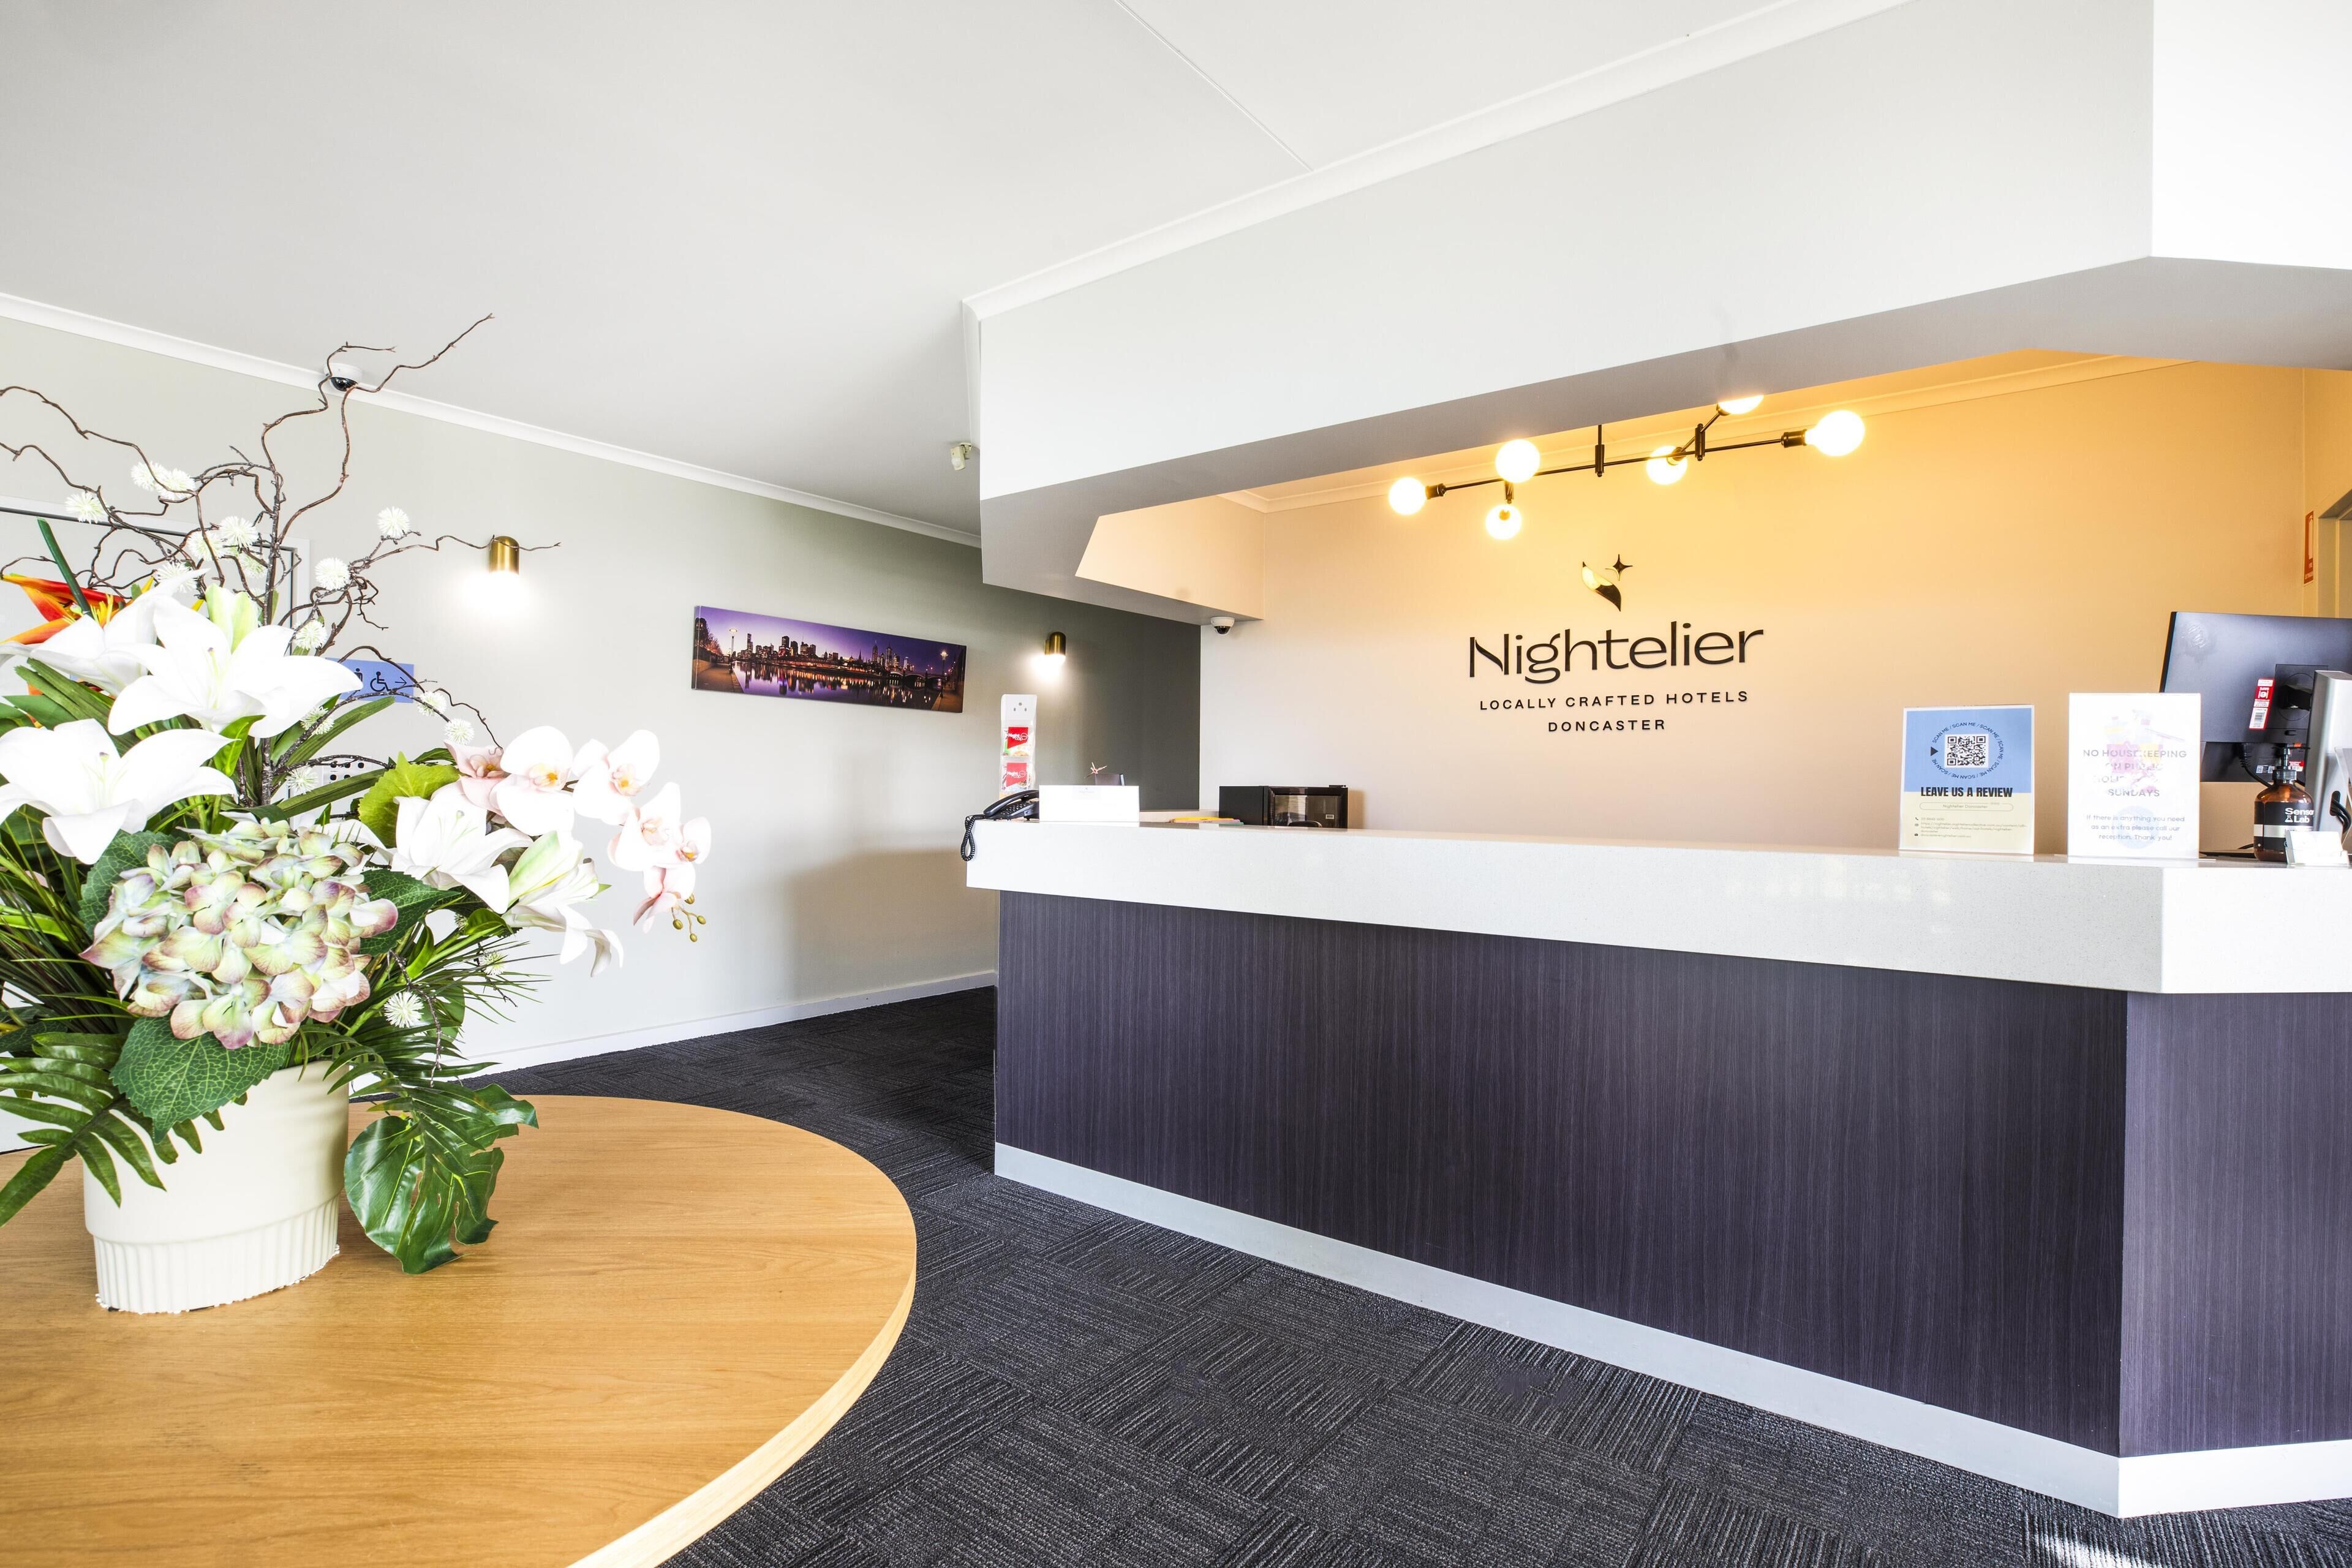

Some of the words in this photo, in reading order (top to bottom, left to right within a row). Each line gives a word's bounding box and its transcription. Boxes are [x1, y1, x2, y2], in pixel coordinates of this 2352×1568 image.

[1469, 620, 1764, 684] Nightelier
[1480, 697, 1557, 710] LOCALLY
[1566, 694, 1656, 708] CRAFTED
[1666, 690, 1749, 704] HOTELS
[1548, 718, 1666, 732] DONCASTER
[1980, 724, 1994, 734] SCAN
[1932, 732, 1942, 743] SCAN
[1936, 763, 1949, 775] SCAN
[1986, 762, 1999, 773] SCAN
[1921, 787, 1949, 797] LEAVE
[1951, 787, 1964, 797] US
[1967, 787, 1973, 797] A
[1976, 787, 2013, 797] REVIEW
